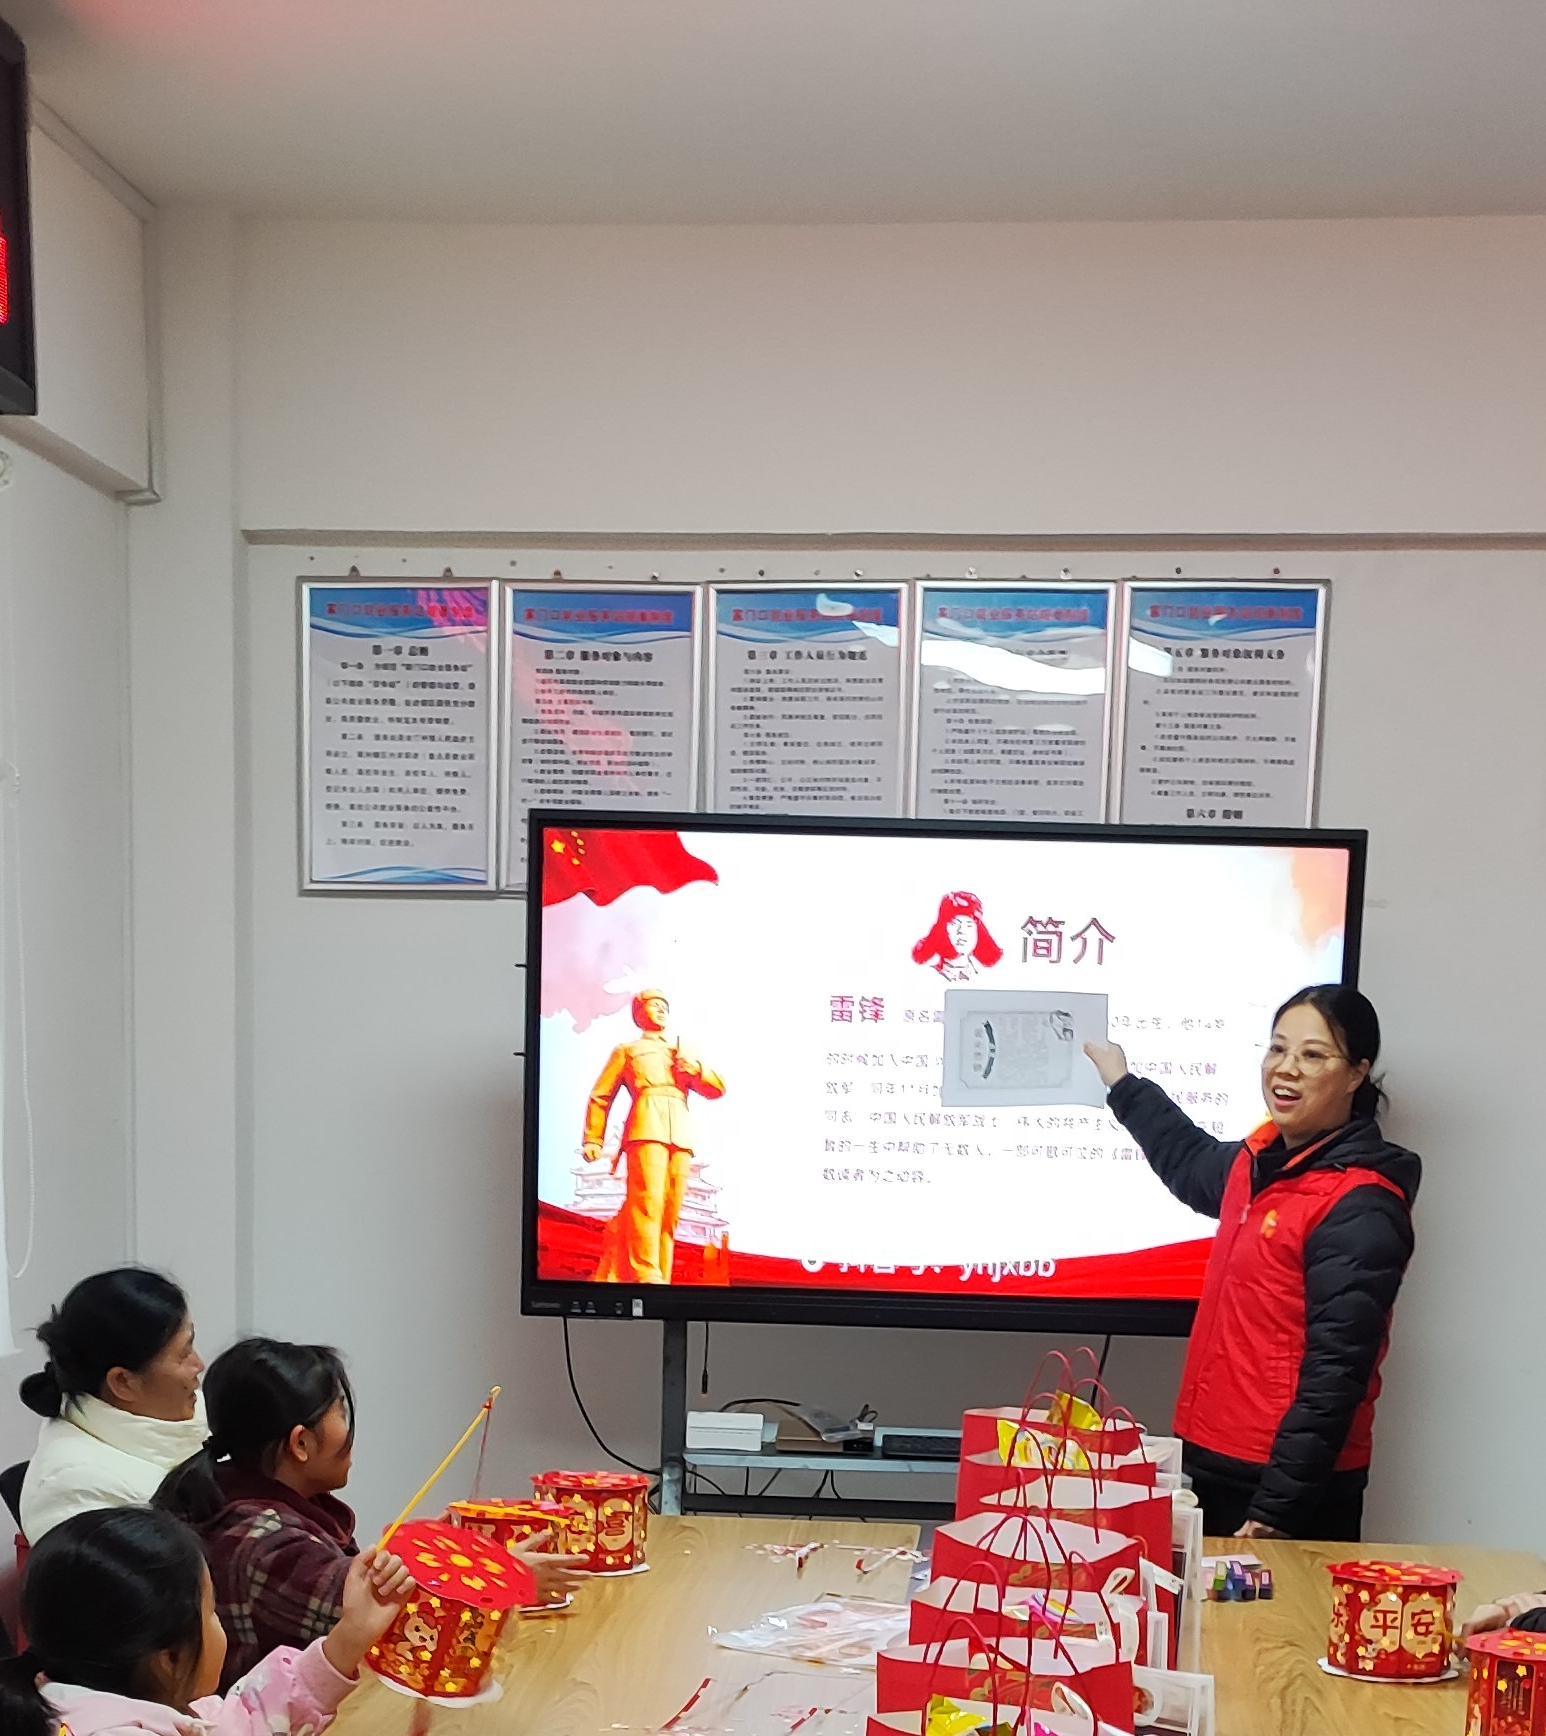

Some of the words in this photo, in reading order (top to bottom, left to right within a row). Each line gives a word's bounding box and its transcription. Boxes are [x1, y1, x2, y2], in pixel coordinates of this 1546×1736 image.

[1021, 915, 1116, 965] 简介
[830, 995, 885, 1023] 雷锋
[1370, 1609, 1436, 1638] 平安
